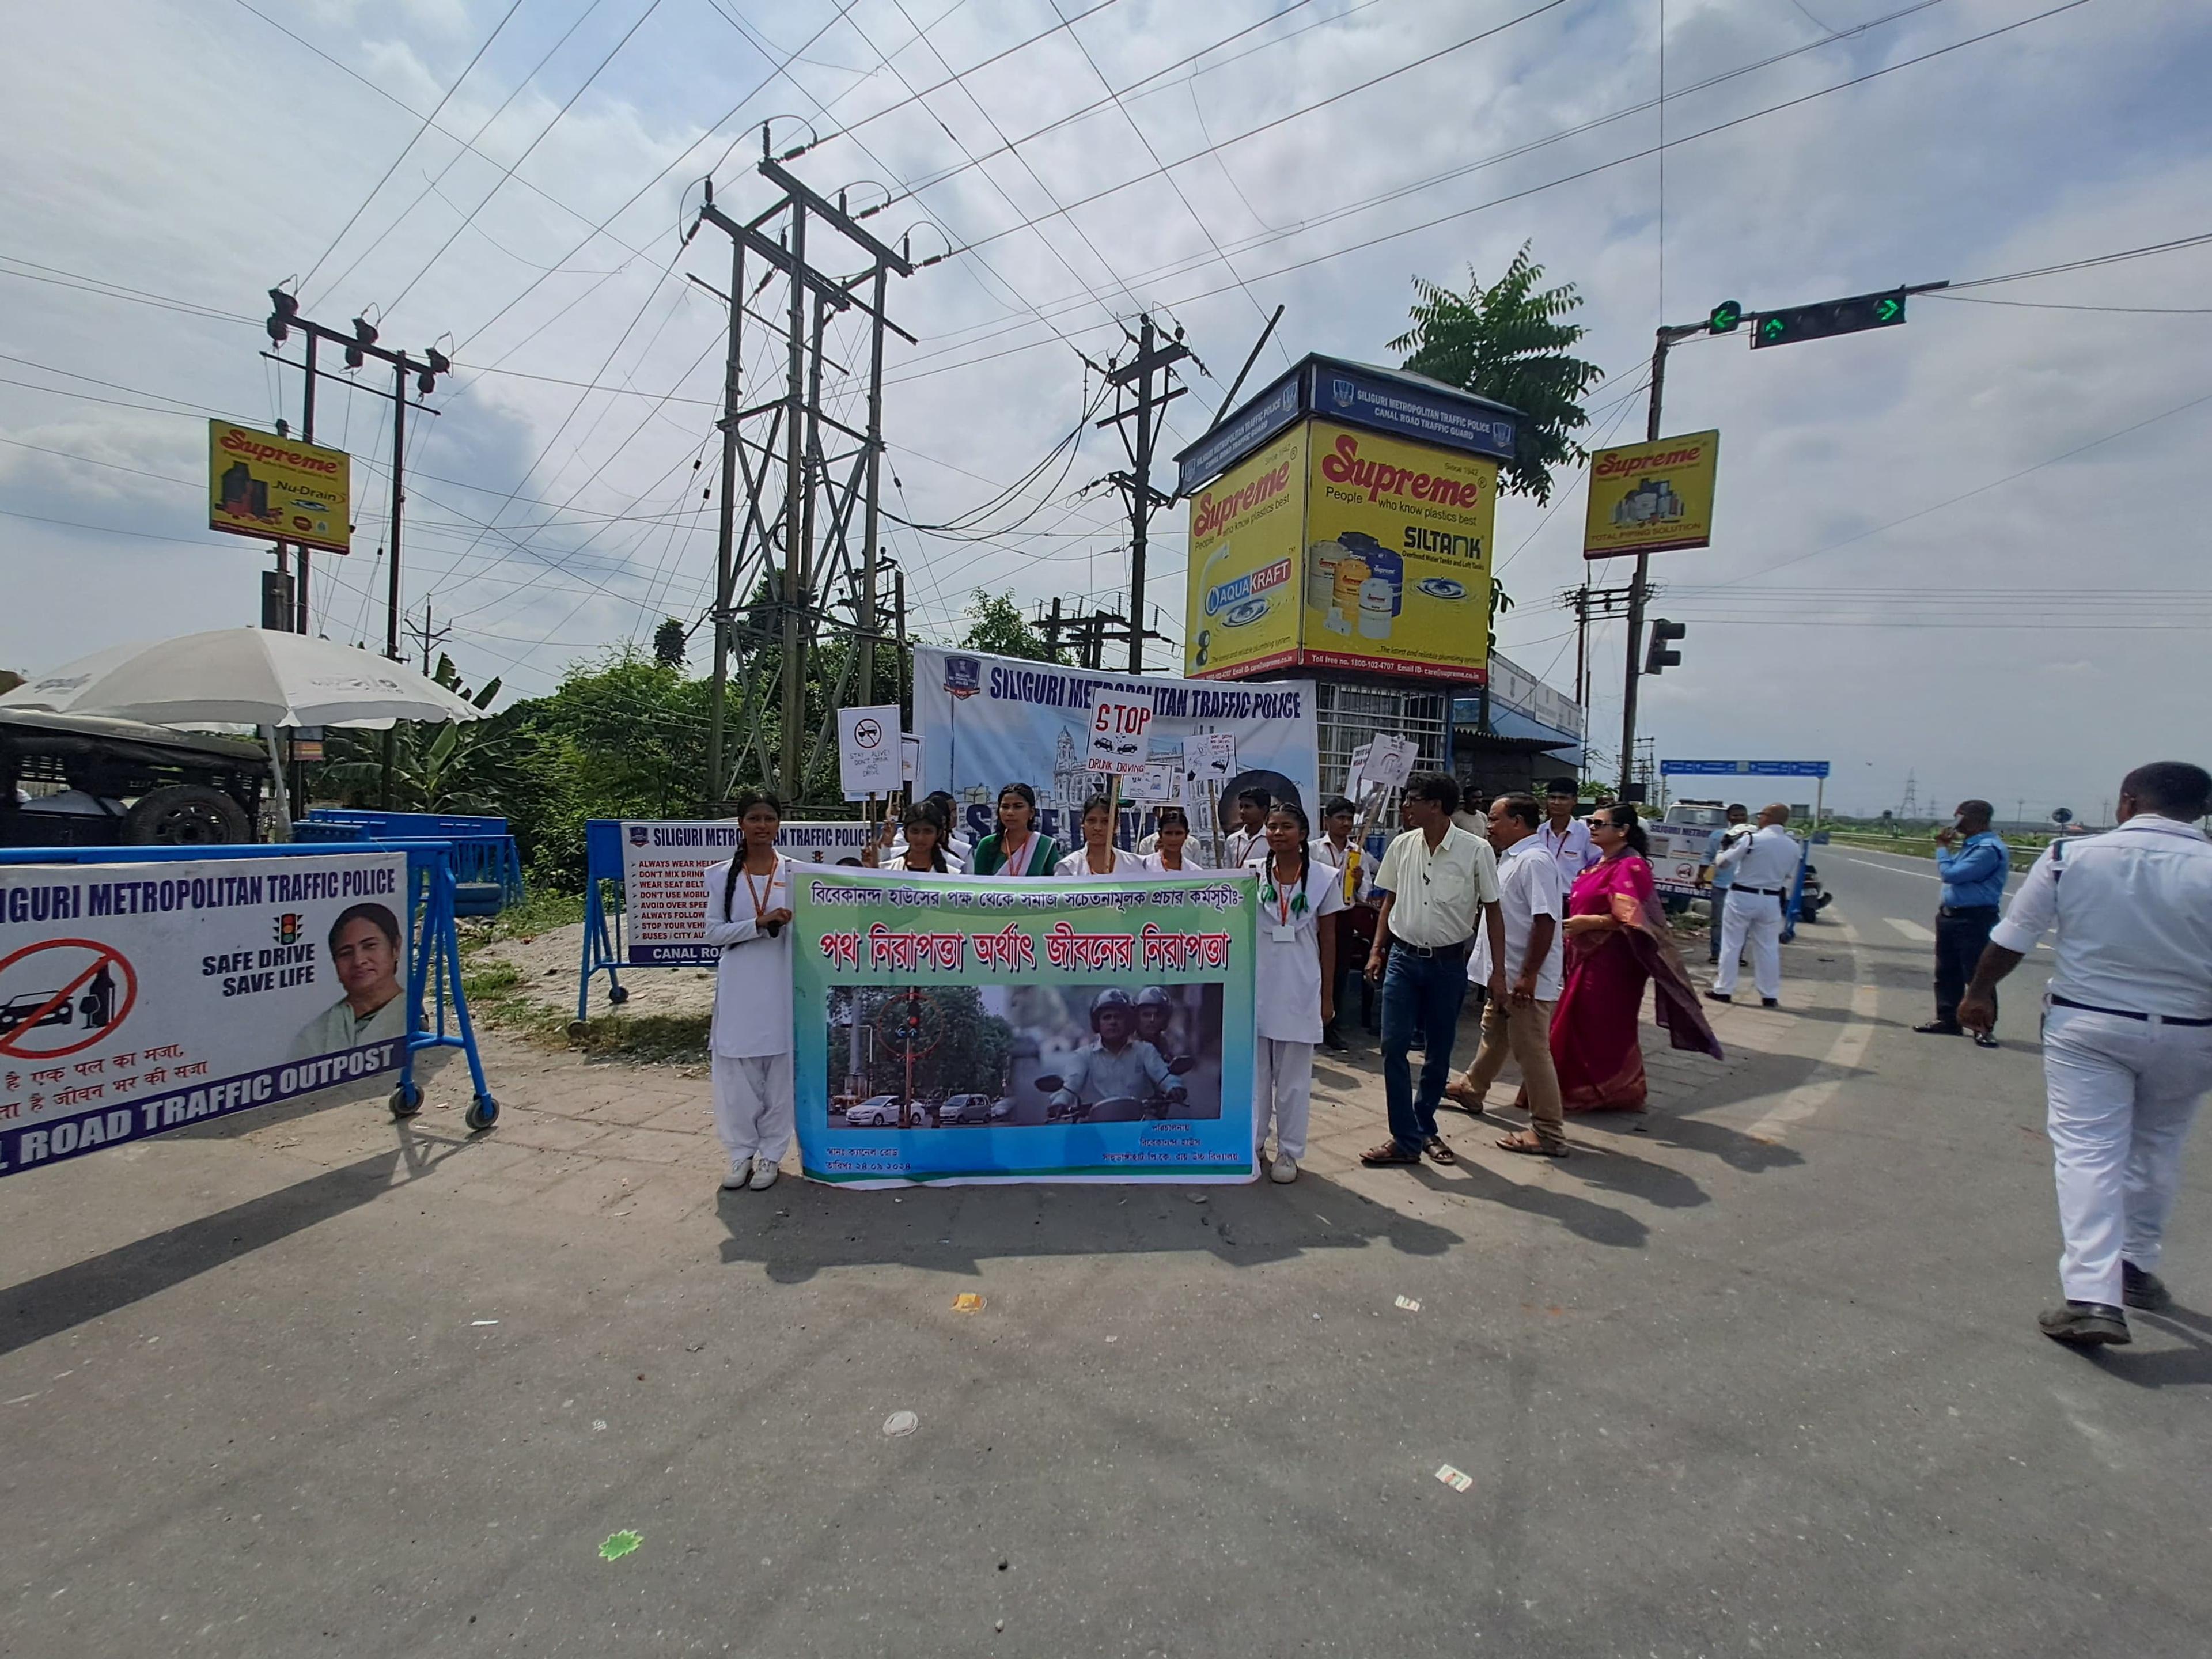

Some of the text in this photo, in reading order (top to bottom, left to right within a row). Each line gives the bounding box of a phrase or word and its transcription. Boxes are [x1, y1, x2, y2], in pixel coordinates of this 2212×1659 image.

[1357, 390, 1490, 434] SILIGURI METROPOLITAN TRAFFIC POLICE
[1375, 408, 1474, 440] CANAL ROAD TRAFFIC GUARD
[219, 429, 338, 474] Supreme
[1595, 447, 1700, 477] Supreme
[1321, 434, 1478, 509] Supreme
[272, 480, 337, 502] Nu-Drain
[1194, 461, 1291, 537] Supreme
[1326, 486, 1477, 526] People who know plastics best
[1195, 536, 1214, 552] People
[1251, 503, 1275, 525] plastics
[1275, 493, 1290, 510] best
[1591, 533, 1617, 542] TOTAL
[1619, 528, 1650, 539] PIPING
[1652, 522, 1701, 536] SOLUTION
[1404, 526, 1481, 560] SILTANK
[1219, 561, 1289, 602] AQUAKRAFT
[1312, 655, 1324, 663] Toll
[1351, 658, 1395, 671] 1800-102-4707
[1397, 664, 1414, 673] Email
[990, 667, 1301, 719] SILIGURI MEITAN TRAFFIC POLICE
[1095, 703, 1151, 736] STOP
[1088, 758, 1145, 773] DRUNK DRIVING
[654, 828, 871, 847] SILIGURI METROAN TRAFFIC POLICE
[89, 875, 262, 917] METROPOLITAN
[267, 871, 339, 903] TRAFFIC
[343, 868, 395, 897] POLICE
[811, 881, 882, 906] বিবেকানন্দ
[889, 884, 941, 907] হাউসের
[948, 891, 974, 908] পক্ষ
[979, 891, 1015, 908] থেকে
[1021, 892, 1058, 908] সমাজ
[1065, 891, 1146, 912] সচেতনামূলক
[1152, 889, 1184, 906] প্রচার
[202, 944, 315, 976] SAFE DRIVE
[653, 948, 698, 959] CANAL
[820, 921, 1232, 971] পথ নিরাপত্তা অর্থাৎ জীবনের নিরাপত্তা
[222, 965, 315, 997] SAVE LIFE
[6, 1071, 20, 1091] है
[31, 1067, 65, 1086] एक
[74, 1059, 105, 1076] पल
[113, 1052, 137, 1067] का
[29, 1093, 44, 1112] है
[54, 1086, 105, 1105] जीवन
[112, 1076, 138, 1092] भर
[144, 1067, 167, 1085] की
[175, 1061, 208, 1077] सजा
[20, 1109, 132, 1164] ROAD
[142, 1074, 272, 1131] TRAFFIC
[279, 1044, 395, 1094] OUTPOST
